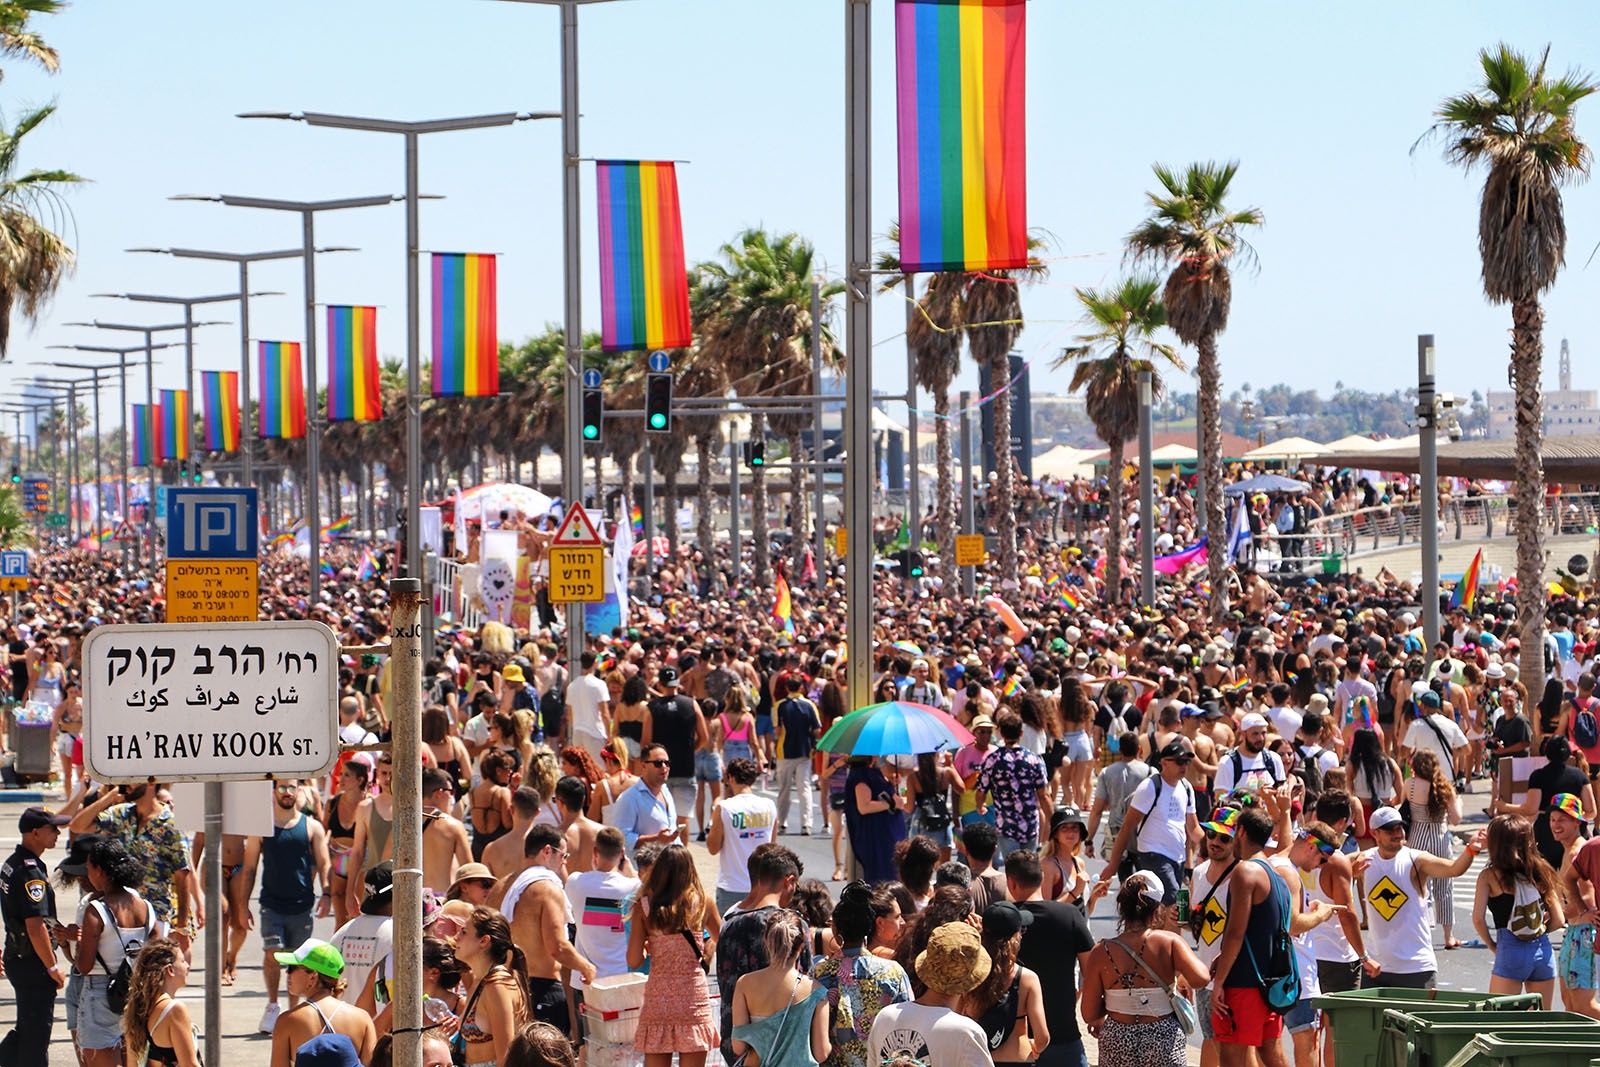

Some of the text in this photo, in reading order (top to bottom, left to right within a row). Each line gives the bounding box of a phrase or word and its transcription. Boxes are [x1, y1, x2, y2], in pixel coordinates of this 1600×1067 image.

[559, 553, 594, 564] רמזור
[177, 564, 248, 576] חניה בתשלום
[562, 569, 591, 580] חדש
[176, 590, 198, 599] 19:00
[201, 590, 212, 599] עד
[559, 584, 594, 597] לפניך
[106, 645, 176, 686] קוק
[193, 644, 265, 675] הרב
[126, 687, 169, 712] كوك
[255, 686, 299, 715] شارع
[107, 731, 319, 760] HA'RAV KOOK ST.
